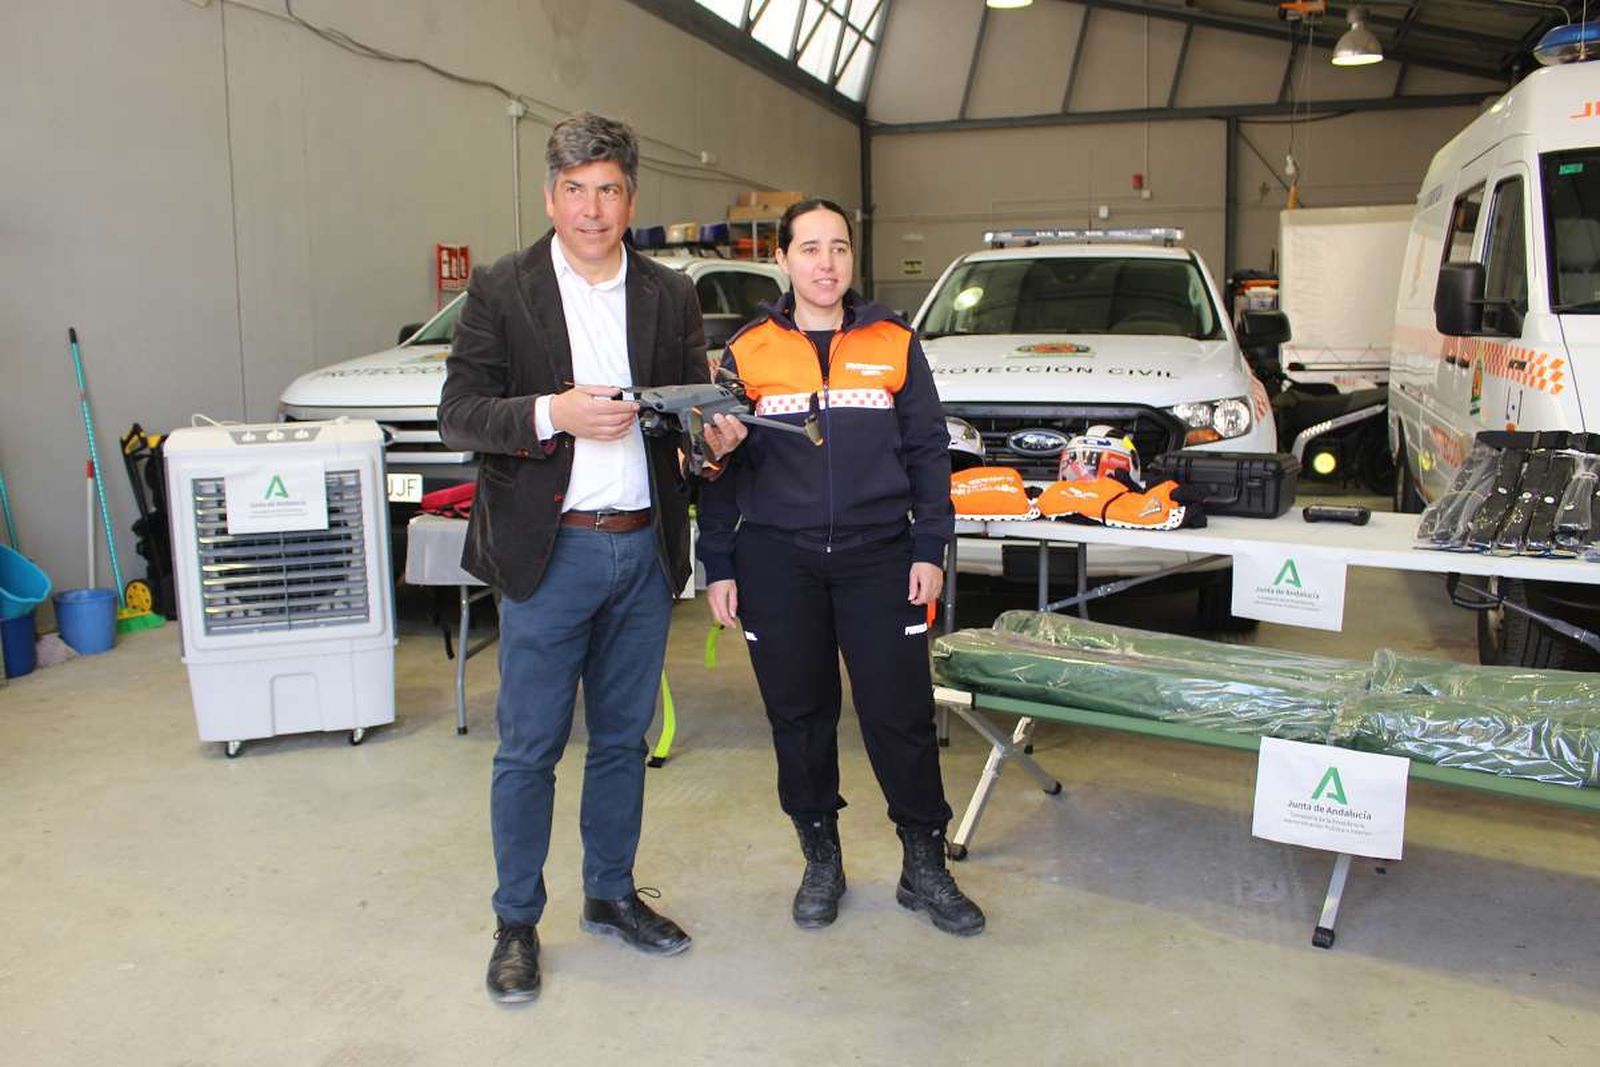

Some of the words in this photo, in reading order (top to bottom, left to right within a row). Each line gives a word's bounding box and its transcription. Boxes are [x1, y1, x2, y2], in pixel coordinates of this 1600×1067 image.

[1108, 367, 1181, 379] CIVIL
[1287, 799, 1312, 811] Junta
[1313, 803, 1325, 813] de
[1326, 806, 1372, 820] Andalucía
